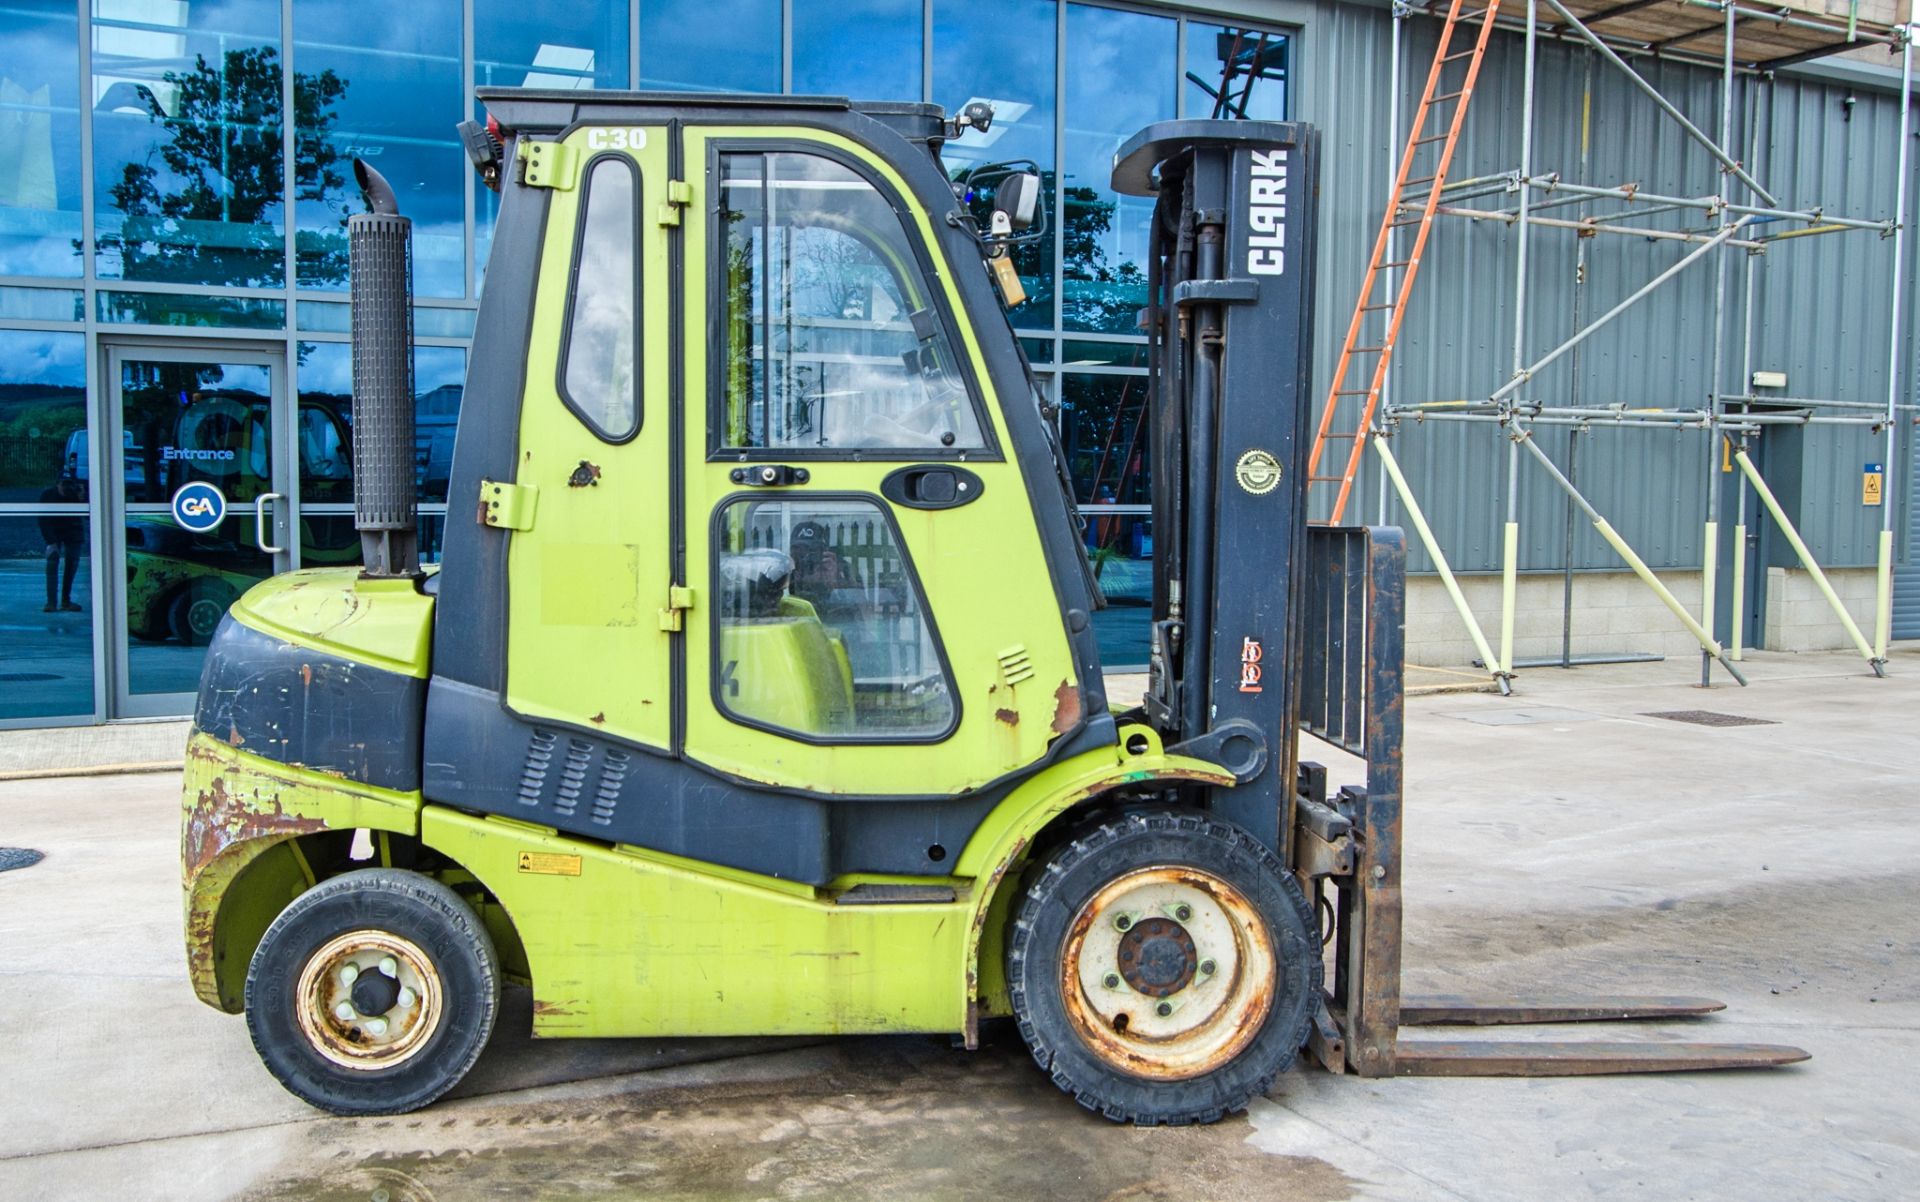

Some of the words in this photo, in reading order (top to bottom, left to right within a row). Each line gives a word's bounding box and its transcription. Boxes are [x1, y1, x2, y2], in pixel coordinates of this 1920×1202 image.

[588, 128, 647, 150] C30
[1247, 149, 1288, 276] CLARK
[163, 446, 235, 460] Entrance
[181, 497, 216, 517] GA
